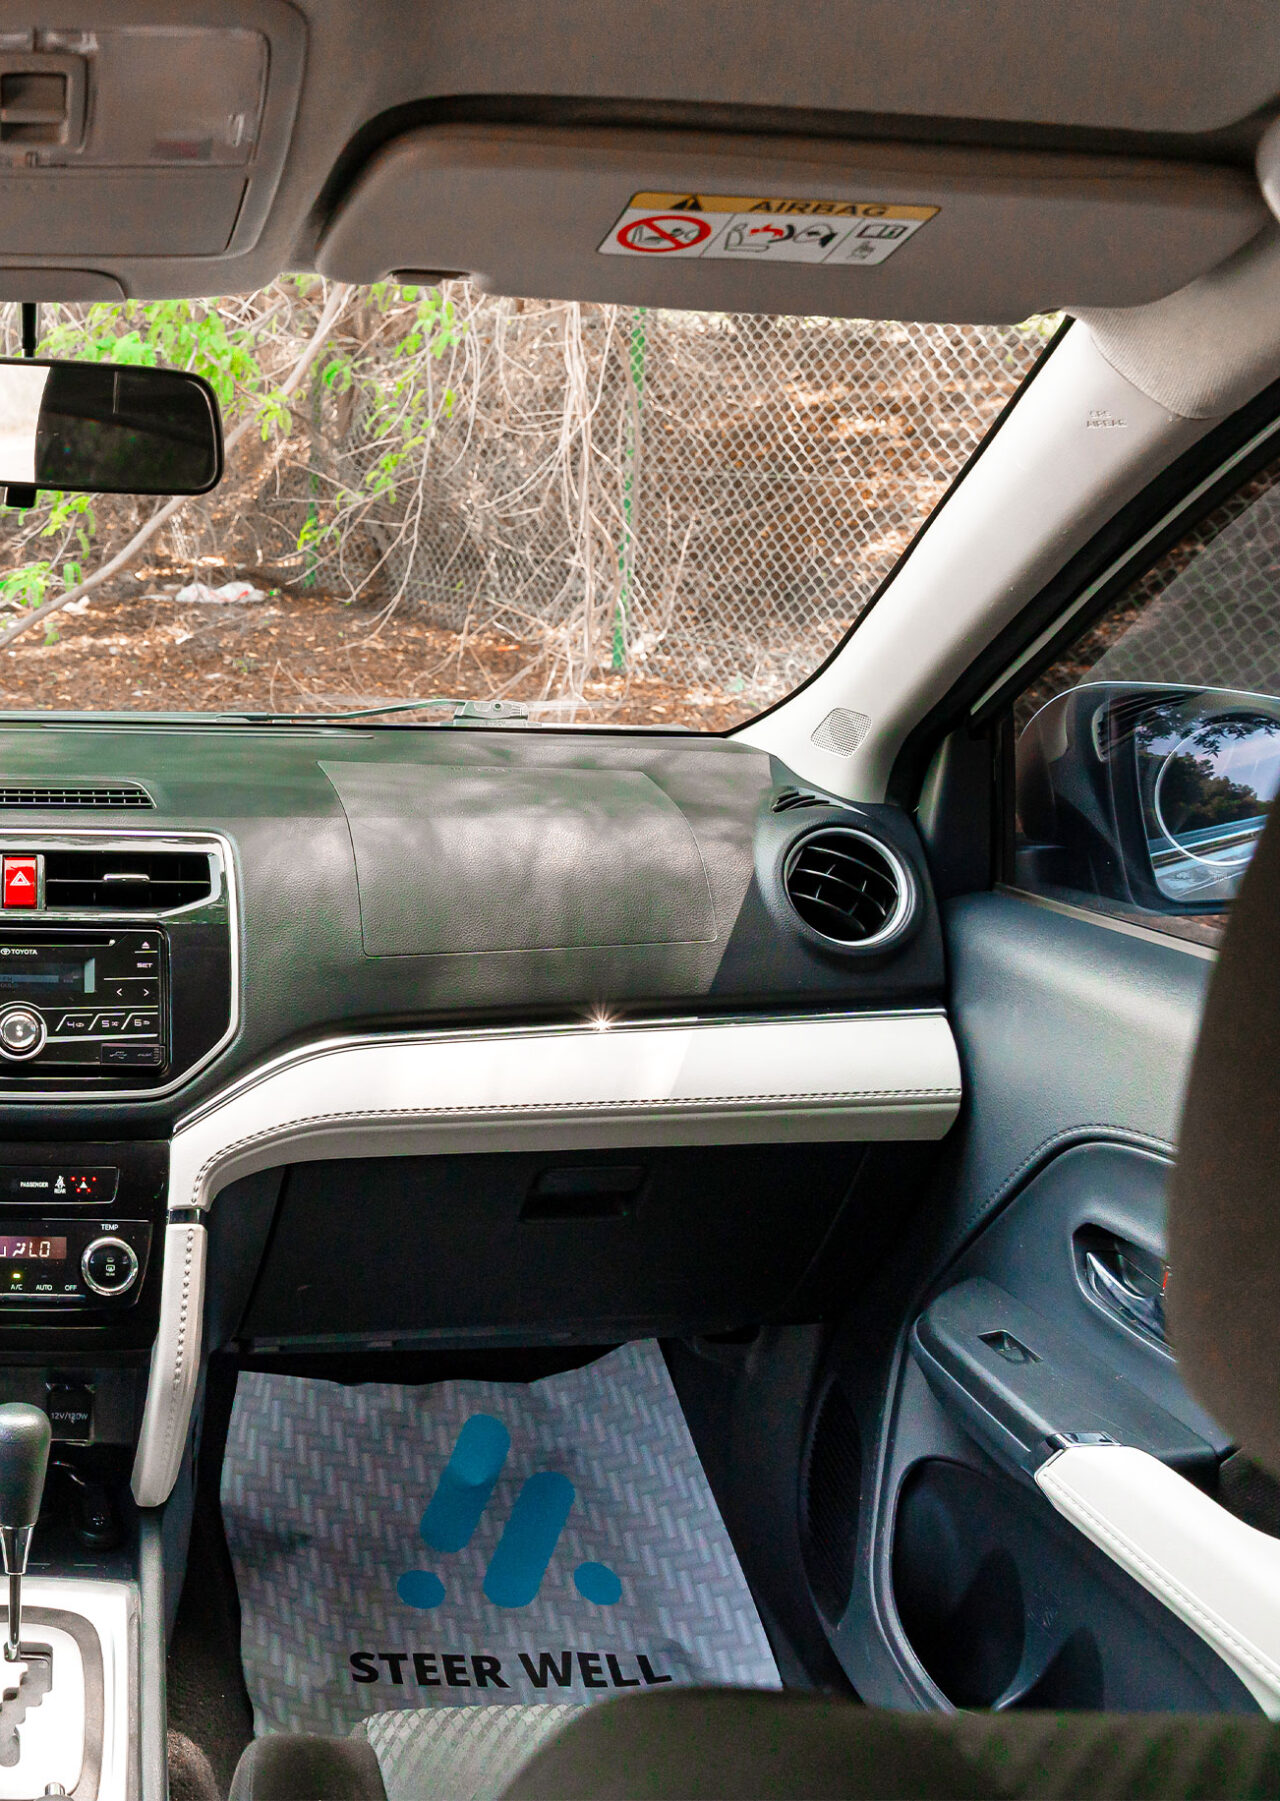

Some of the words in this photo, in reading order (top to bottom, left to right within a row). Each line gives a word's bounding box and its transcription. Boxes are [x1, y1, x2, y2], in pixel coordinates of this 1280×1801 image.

[749, 200, 887, 217] AIRBAG
[101, 1020, 110, 1028] 5
[134, 1019, 142, 1027] 6
[100, 1223, 119, 1231] TEMP
[349, 1652, 511, 1688] STEER
[518, 1651, 673, 1688] WELL
